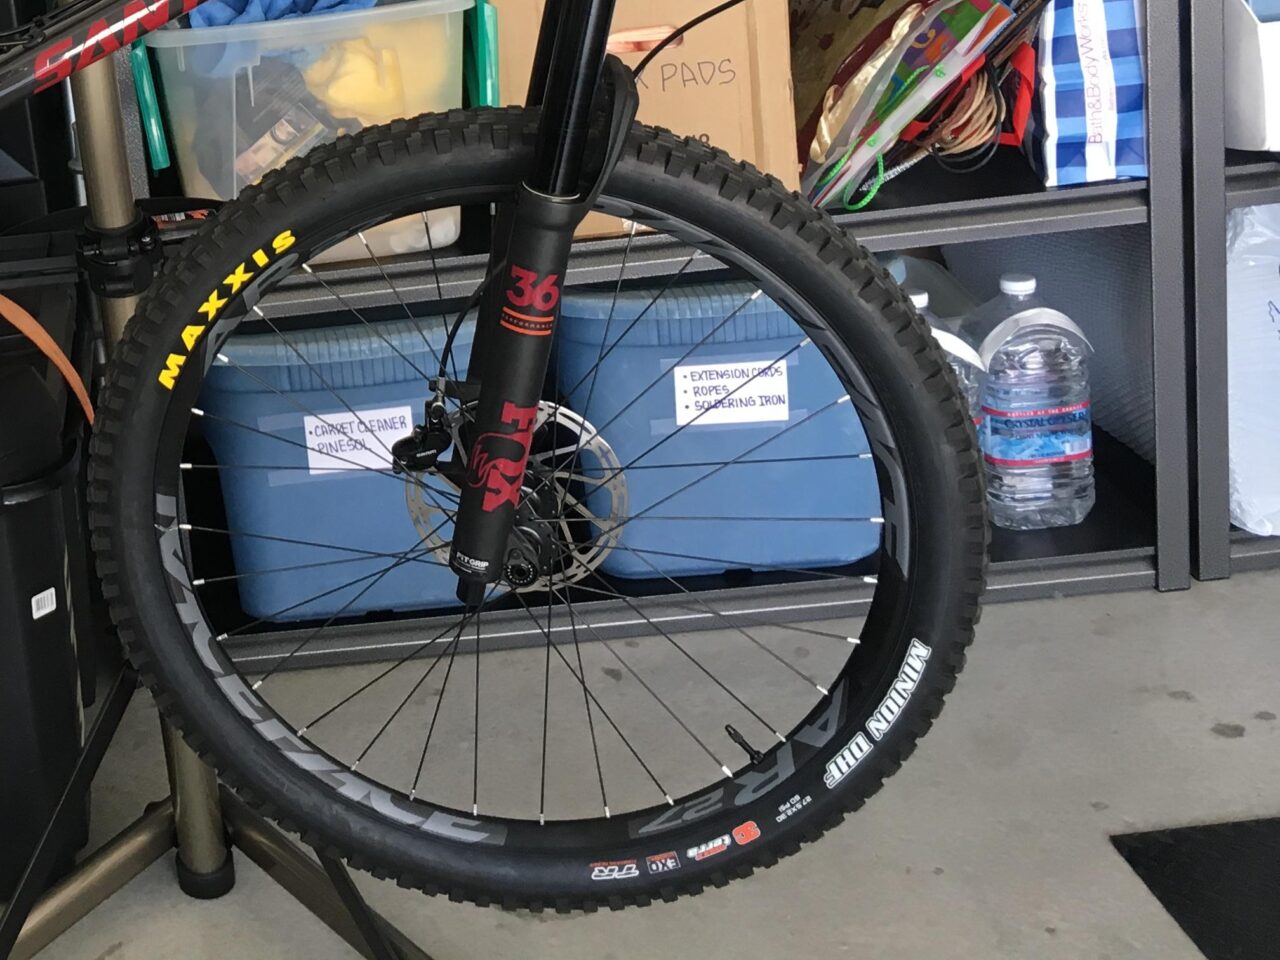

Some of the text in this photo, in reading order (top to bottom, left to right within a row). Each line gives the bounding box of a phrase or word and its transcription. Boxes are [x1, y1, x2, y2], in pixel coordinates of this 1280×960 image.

[661, 58, 736, 92] PADS
[506, 264, 560, 312] 36
[158, 230, 296, 390] MAXXIS
[690, 366, 783, 382] EXTENSION CORDS
[693, 385, 730, 397] ROPES
[695, 394, 786, 411] SOLDERING IRON
[314, 415, 408, 438] CARPET CLEANER
[469, 401, 539, 512] FOX
[823, 638, 932, 789] MINION DHF
[648, 857, 679, 873] EXO
